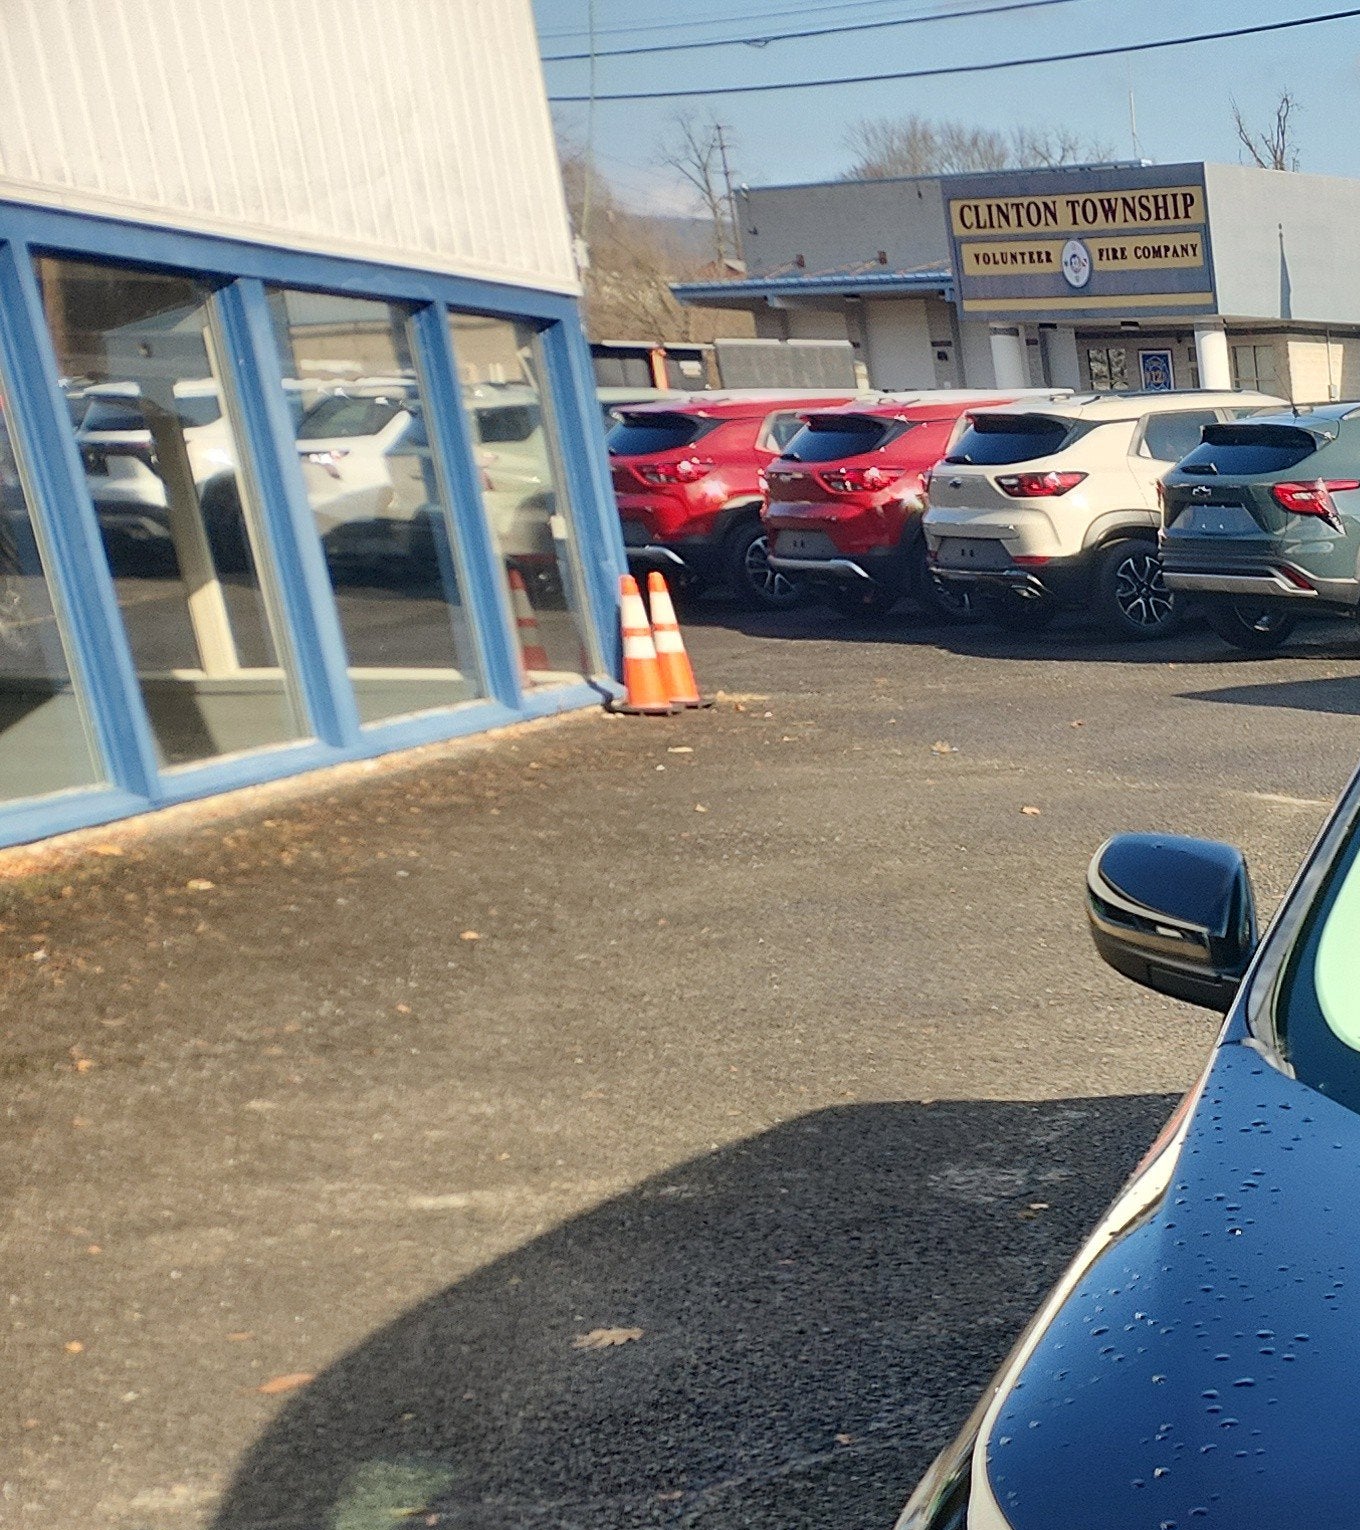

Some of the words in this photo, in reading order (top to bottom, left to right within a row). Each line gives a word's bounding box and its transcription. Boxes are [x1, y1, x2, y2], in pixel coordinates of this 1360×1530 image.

[959, 200, 1058, 230] CLINTON
[1066, 192, 1195, 226] TOWNSHIP
[973, 250, 1053, 266] VOLUNTEER
[1098, 246, 1128, 261] FIRE
[1133, 243, 1198, 260] COMPANY
